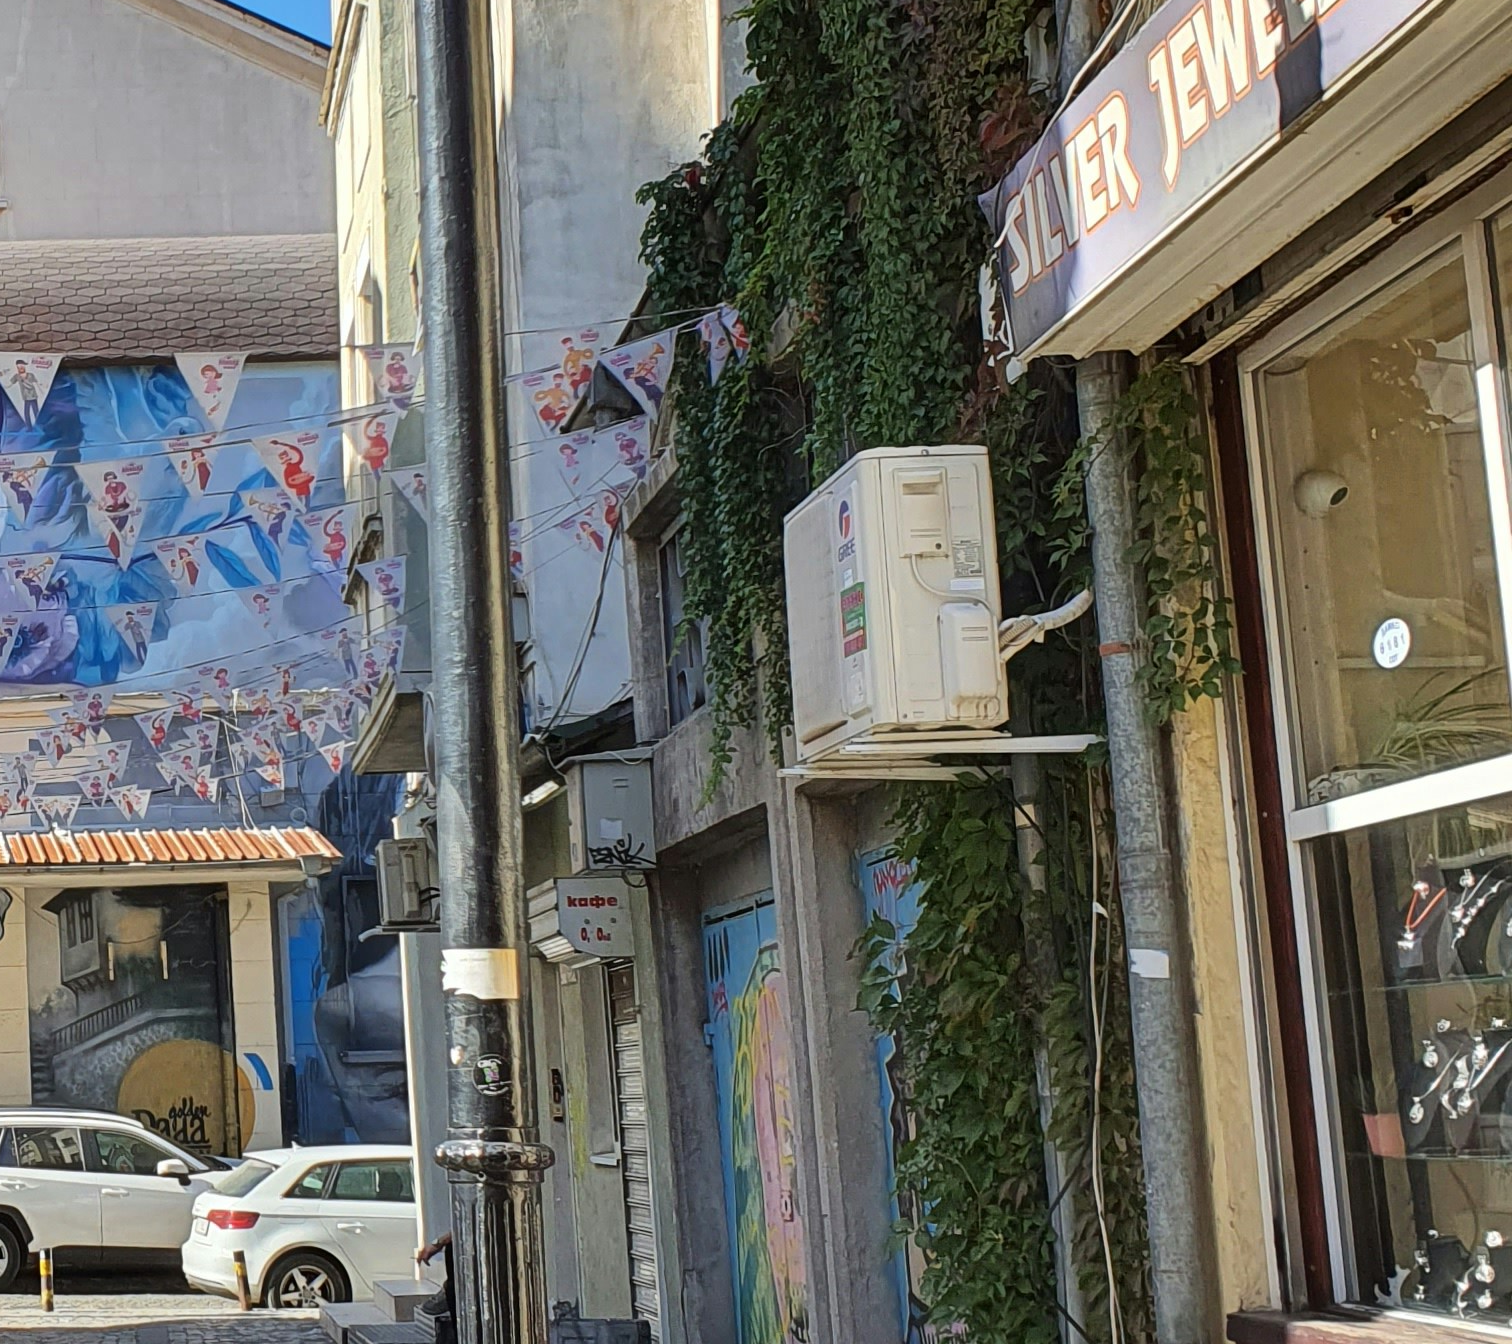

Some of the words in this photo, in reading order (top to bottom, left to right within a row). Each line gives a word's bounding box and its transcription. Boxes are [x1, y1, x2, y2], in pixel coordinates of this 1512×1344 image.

[1004, 90, 1141, 297] SILVER
[838, 537, 855, 562] GREE
[567, 895, 618, 908] кафе
[169, 1096, 211, 1131] golden
